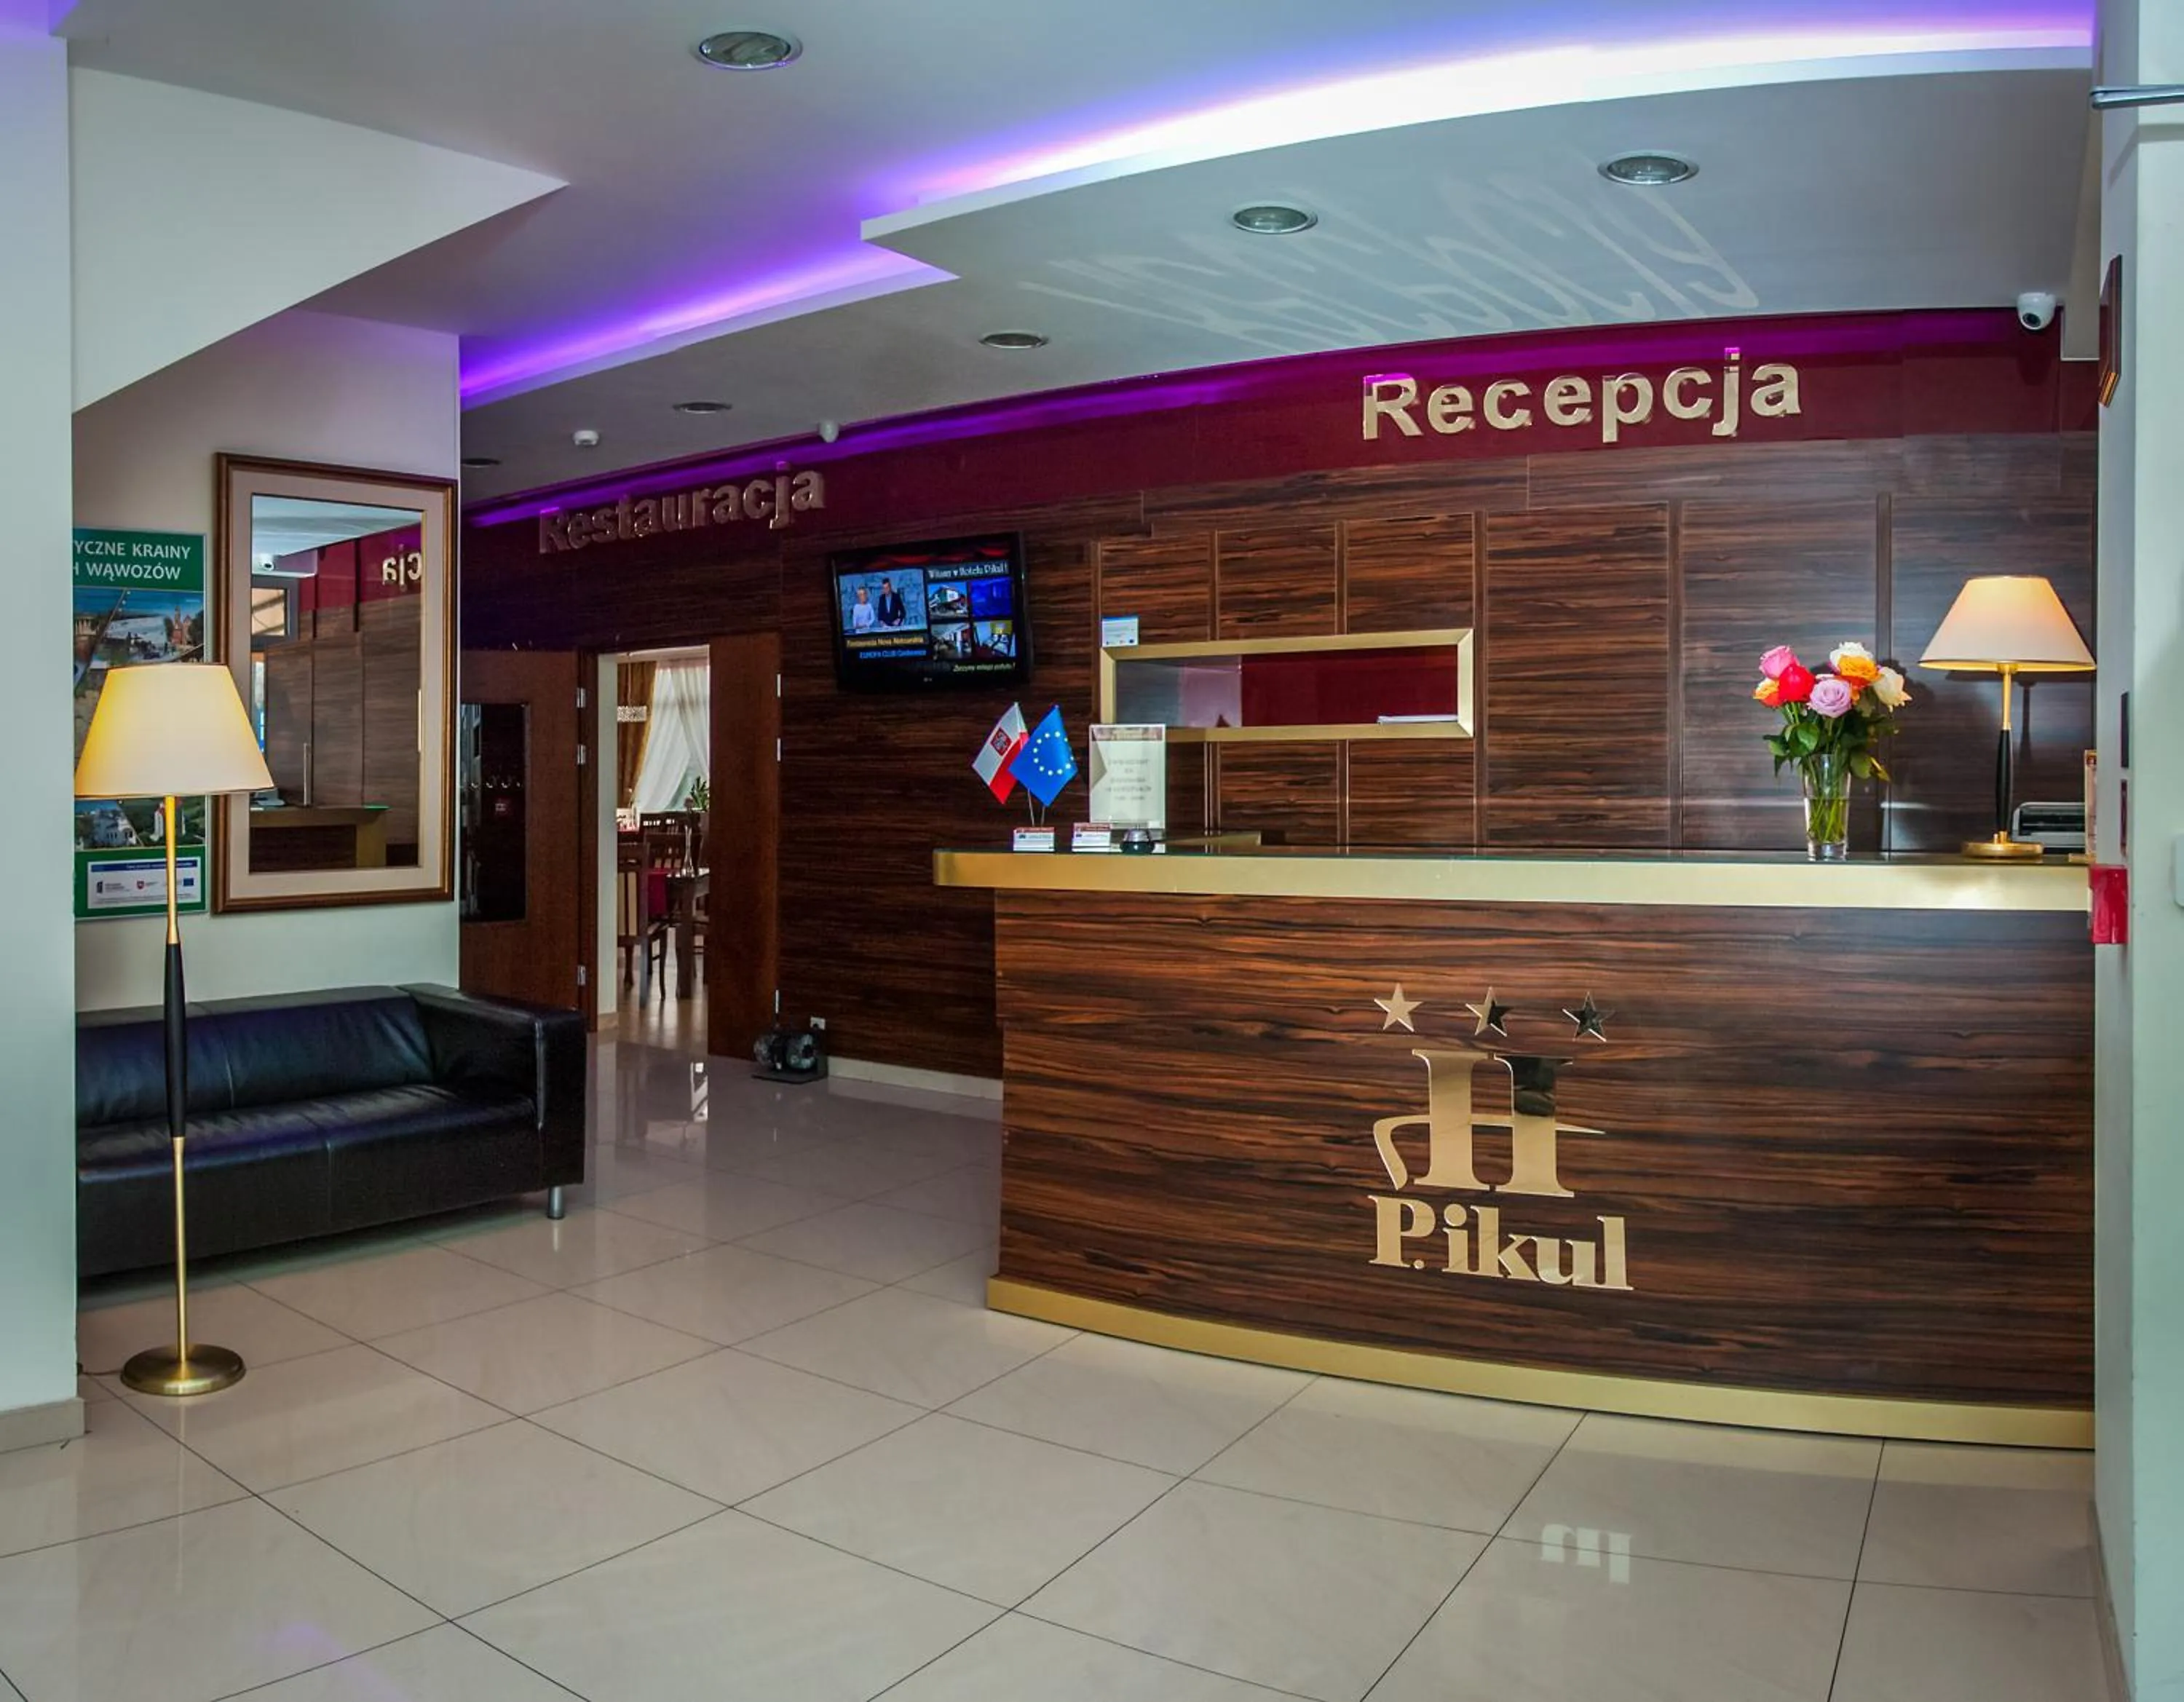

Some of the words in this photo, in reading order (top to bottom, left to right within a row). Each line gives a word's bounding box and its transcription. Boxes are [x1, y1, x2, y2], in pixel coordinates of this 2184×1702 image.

[1363, 347, 1802, 443] Recepcja
[539, 460, 826, 553] Restauracja
[85, 561, 181, 582] WĄWOZÓW
[132, 543, 191, 560] KRAINY
